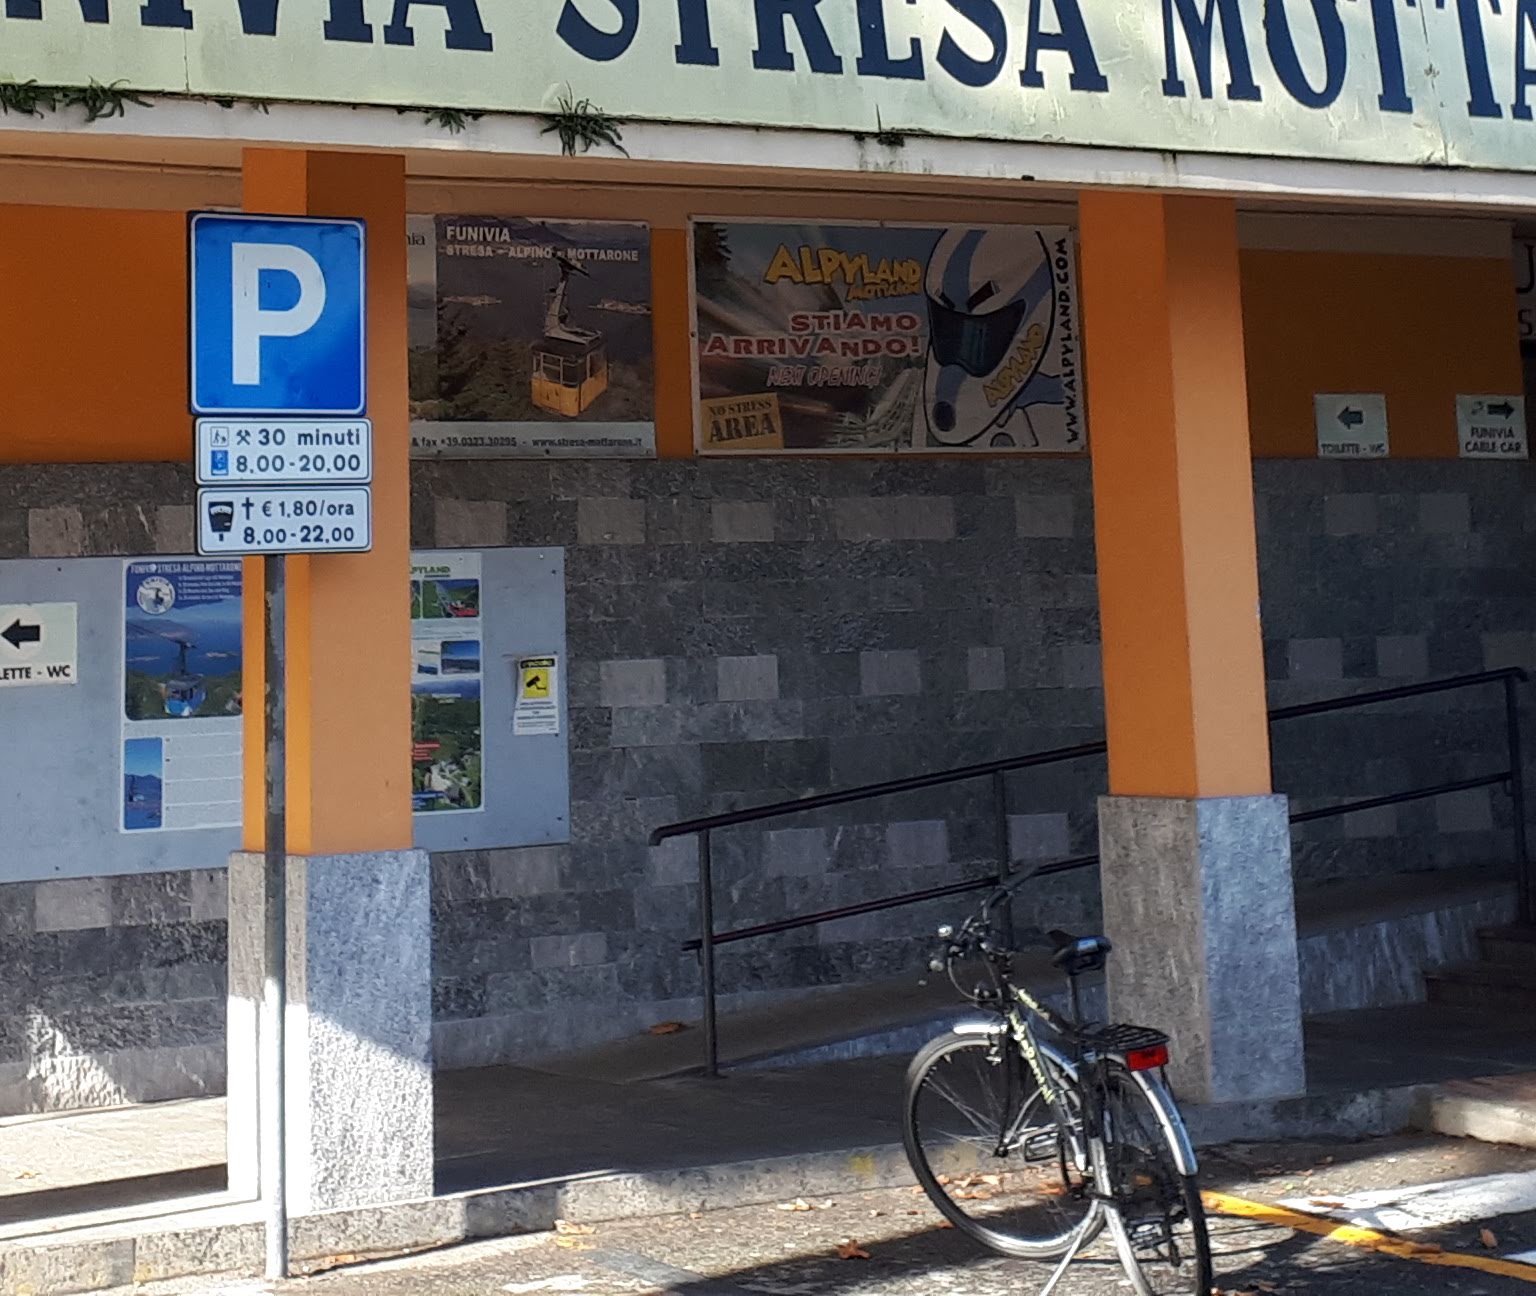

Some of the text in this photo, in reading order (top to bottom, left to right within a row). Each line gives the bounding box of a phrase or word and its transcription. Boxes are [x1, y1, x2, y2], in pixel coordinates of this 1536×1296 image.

[446, 225, 512, 243] FUNIVIA
[446, 244, 494, 257] STRESA
[508, 246, 553, 260] ALPINO
[567, 248, 639, 262] MOTTARONE
[764, 242, 924, 286] ALPYLAND
[232, 241, 327, 386] P
[790, 311, 919, 333] STIAMO
[707, 335, 921, 357] ARRIVANDO!
[1055, 238, 1079, 444] WWW.ALPYLAND.COM
[708, 400, 772, 417] NO STRESS
[708, 412, 777, 443] AREA
[1470, 426, 1514, 439] FUNIVIA
[257, 428, 361, 446] 30 minuti
[1465, 440, 1522, 453] CABLE CAR
[46, 664, 71, 678] WC
